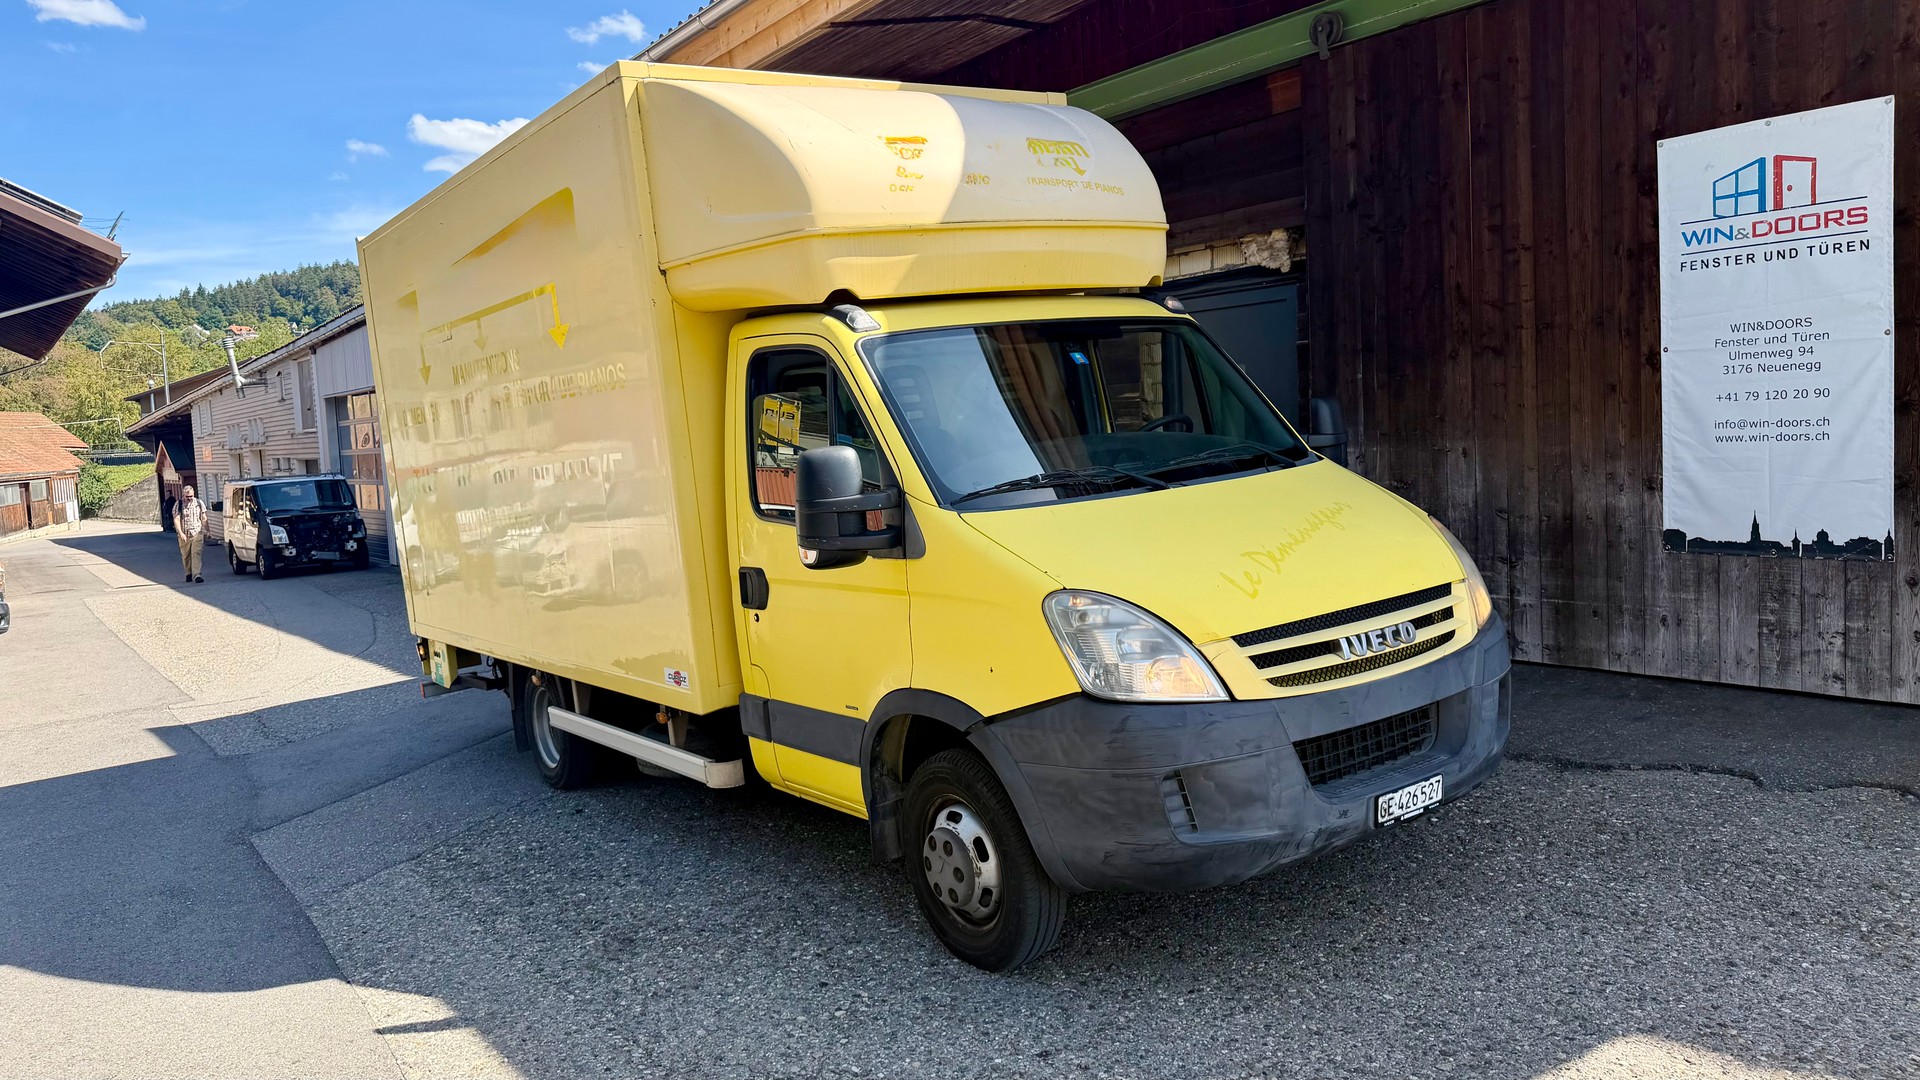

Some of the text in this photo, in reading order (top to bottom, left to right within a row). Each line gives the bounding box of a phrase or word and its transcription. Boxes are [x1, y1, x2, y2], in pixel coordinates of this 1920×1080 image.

[1080, 181, 1094, 190] DE
[1094, 182, 1125, 196] PIANOS
[1681, 206, 1869, 247] WIN&DOORS
[1680, 239, 1870, 272] FENSTER UND TÜREN
[1730, 317, 1813, 333] WIN&DOORS
[1715, 331, 1830, 348] Fenster und Türen
[1728, 346, 1814, 361] Ulmenweg 94
[1722, 360, 1822, 375] 3176 Neuenegg
[1716, 387, 1830, 402] +41 79 120 20 90
[1714, 416, 1830, 430] info@win-doors.ch
[1715, 431, 1830, 443] www.win-doors.ch
[1336, 620, 1417, 661] IVECO
